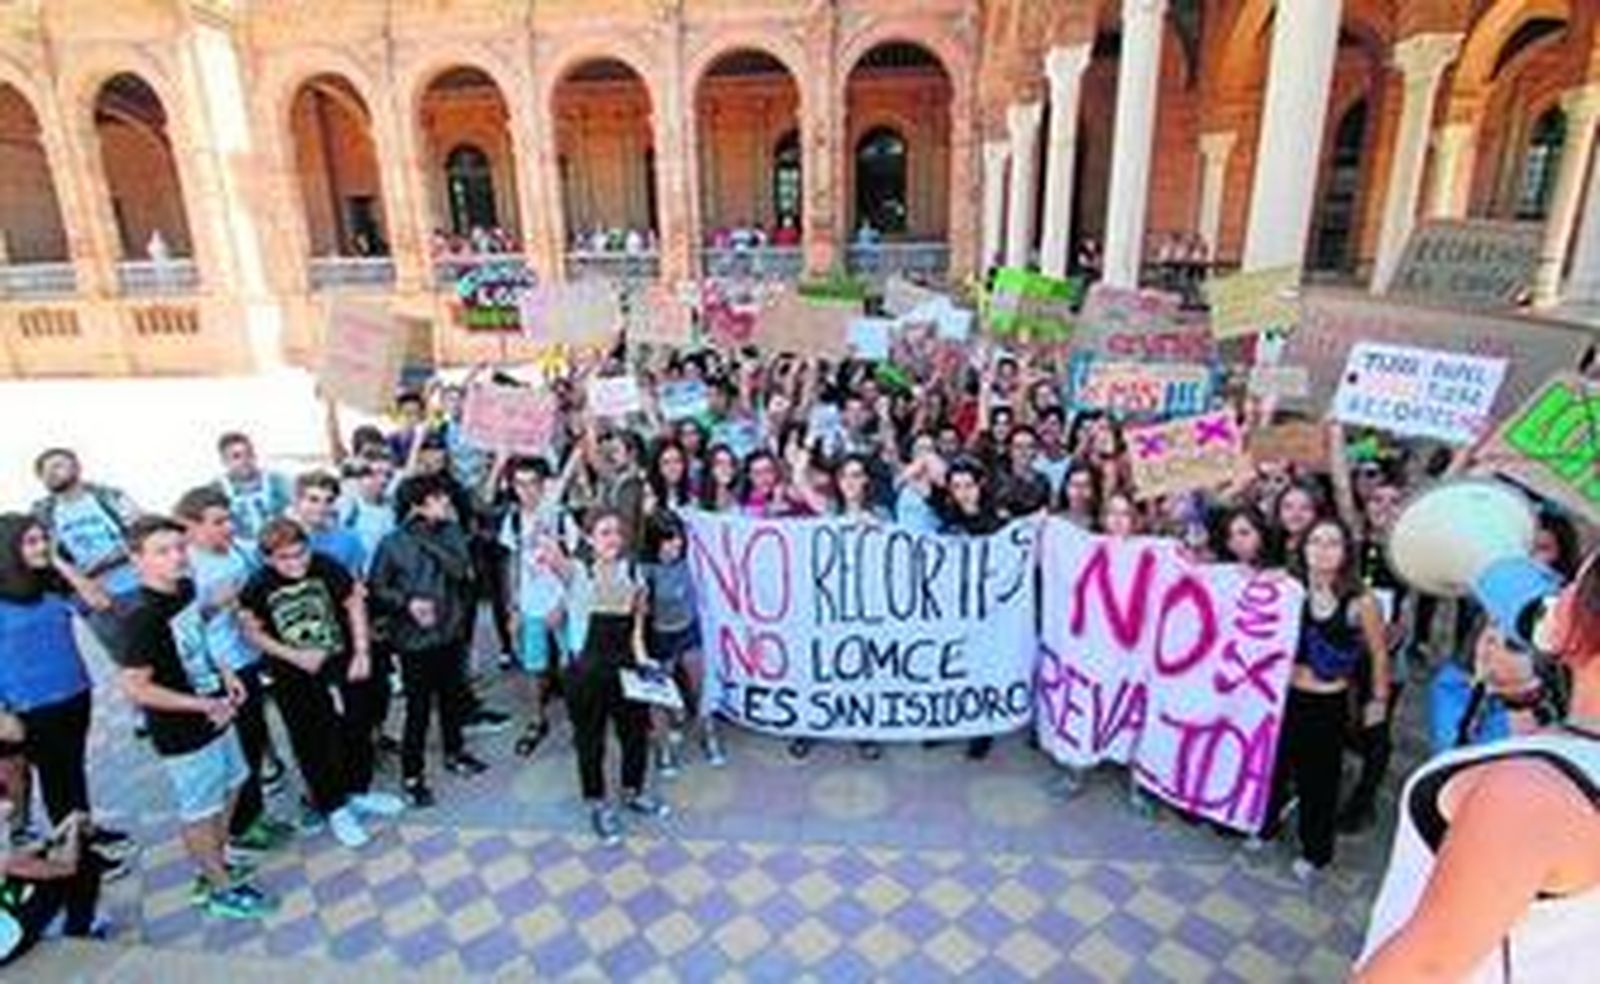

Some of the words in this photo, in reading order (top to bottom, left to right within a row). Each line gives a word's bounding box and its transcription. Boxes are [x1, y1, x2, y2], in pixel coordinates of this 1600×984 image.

[692, 520, 791, 624] NO
[1070, 546, 1217, 677] NO
[718, 626, 790, 681] NO
[811, 634, 968, 684] LOMCE
[808, 691, 875, 731] SAN
[879, 680, 1031, 728] ISIDORO
